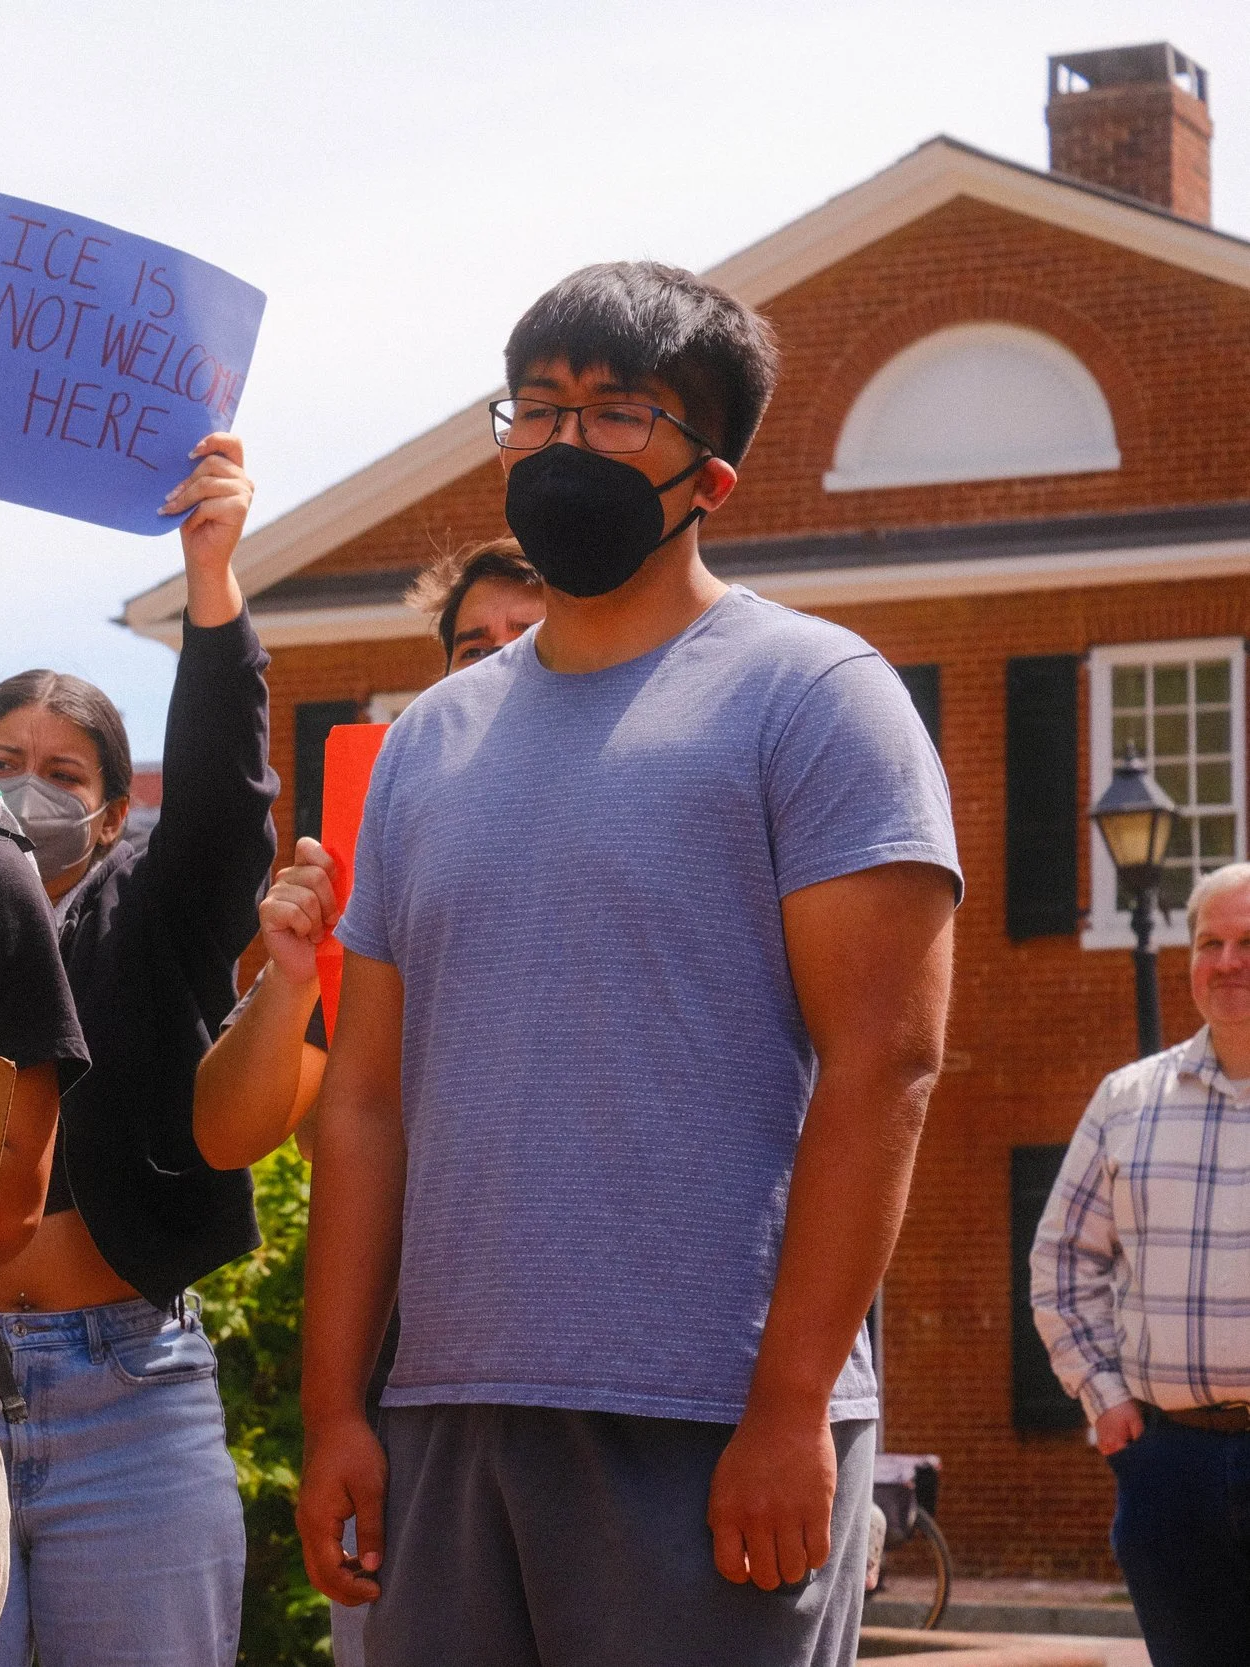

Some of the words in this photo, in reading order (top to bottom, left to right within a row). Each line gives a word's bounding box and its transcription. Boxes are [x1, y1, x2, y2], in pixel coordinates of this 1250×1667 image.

[1, 214, 111, 290] ICE
[129, 260, 176, 319] IS
[23, 368, 170, 471] HERE
